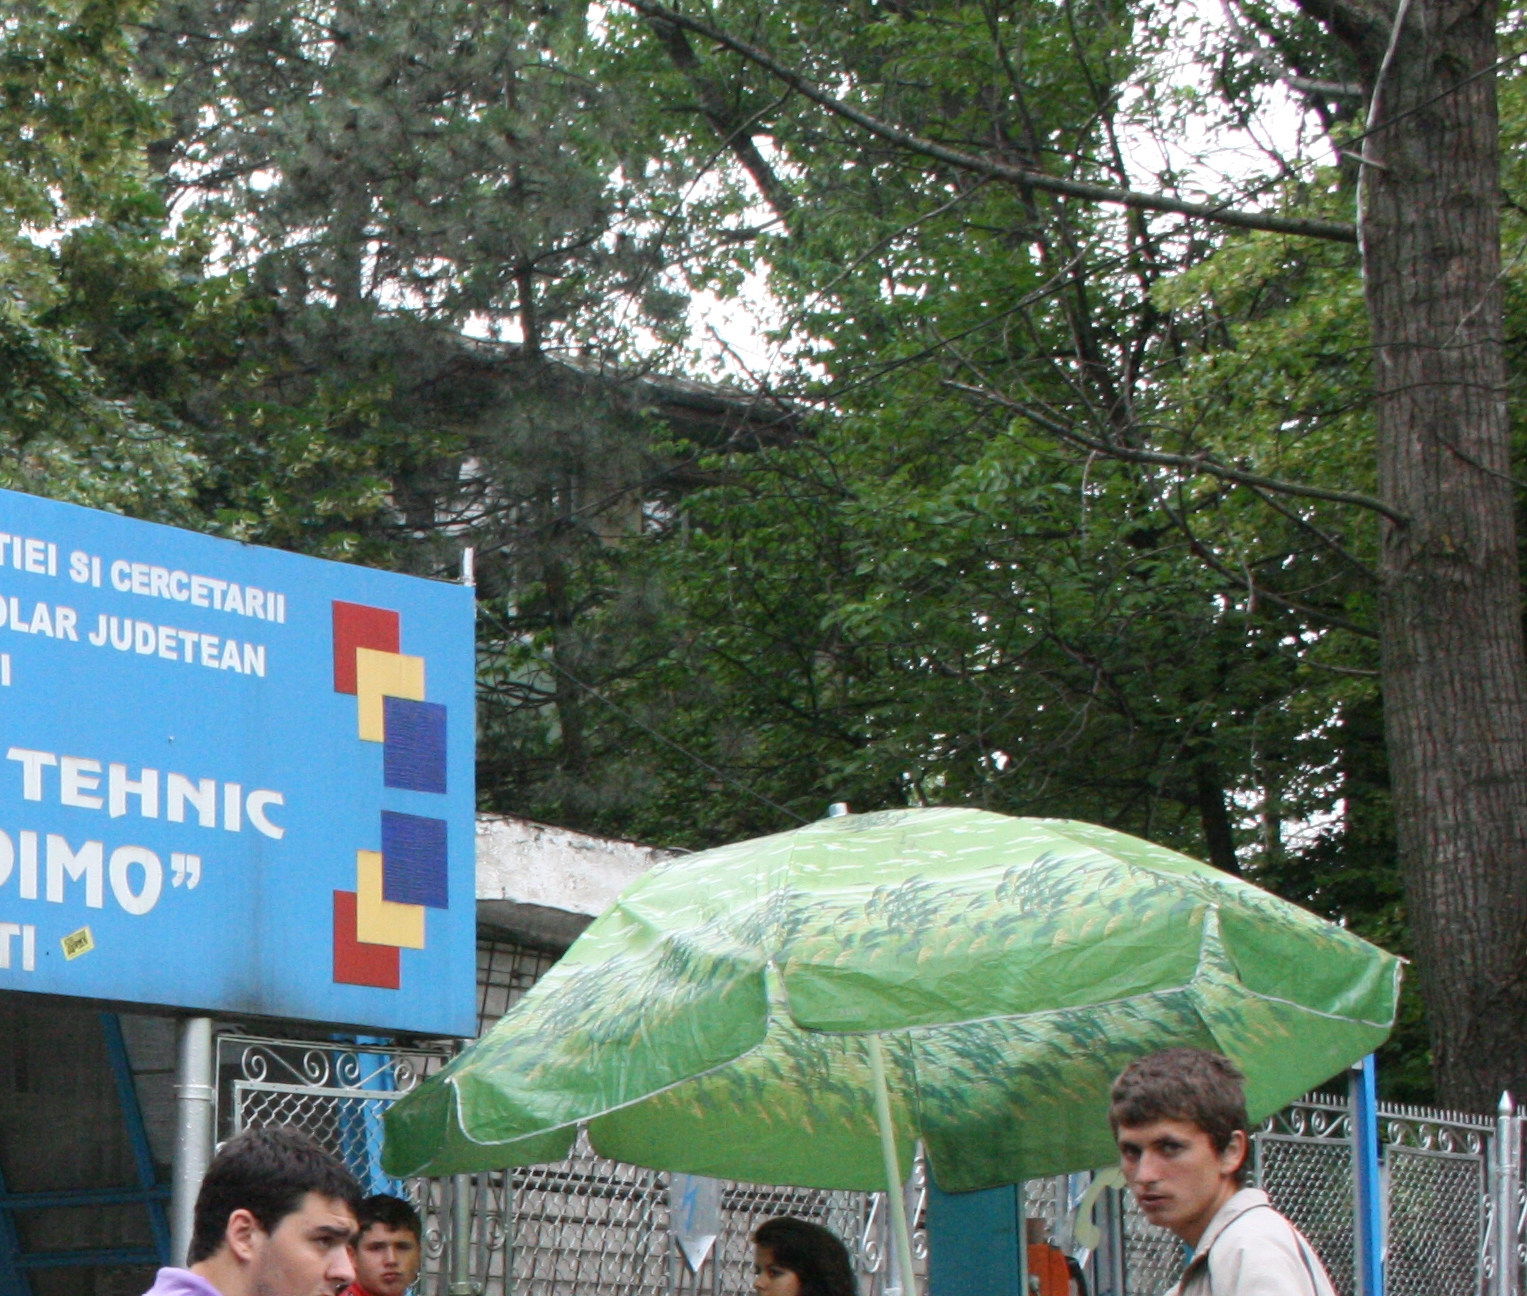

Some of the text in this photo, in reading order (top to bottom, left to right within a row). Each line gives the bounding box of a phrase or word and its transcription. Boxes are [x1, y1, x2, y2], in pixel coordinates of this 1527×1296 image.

[69, 551, 102, 587] SI
[110, 560, 286, 624] CERCETARII
[87, 613, 267, 677] JUDETEAN
[6, 747, 285, 840] TEHNIC
